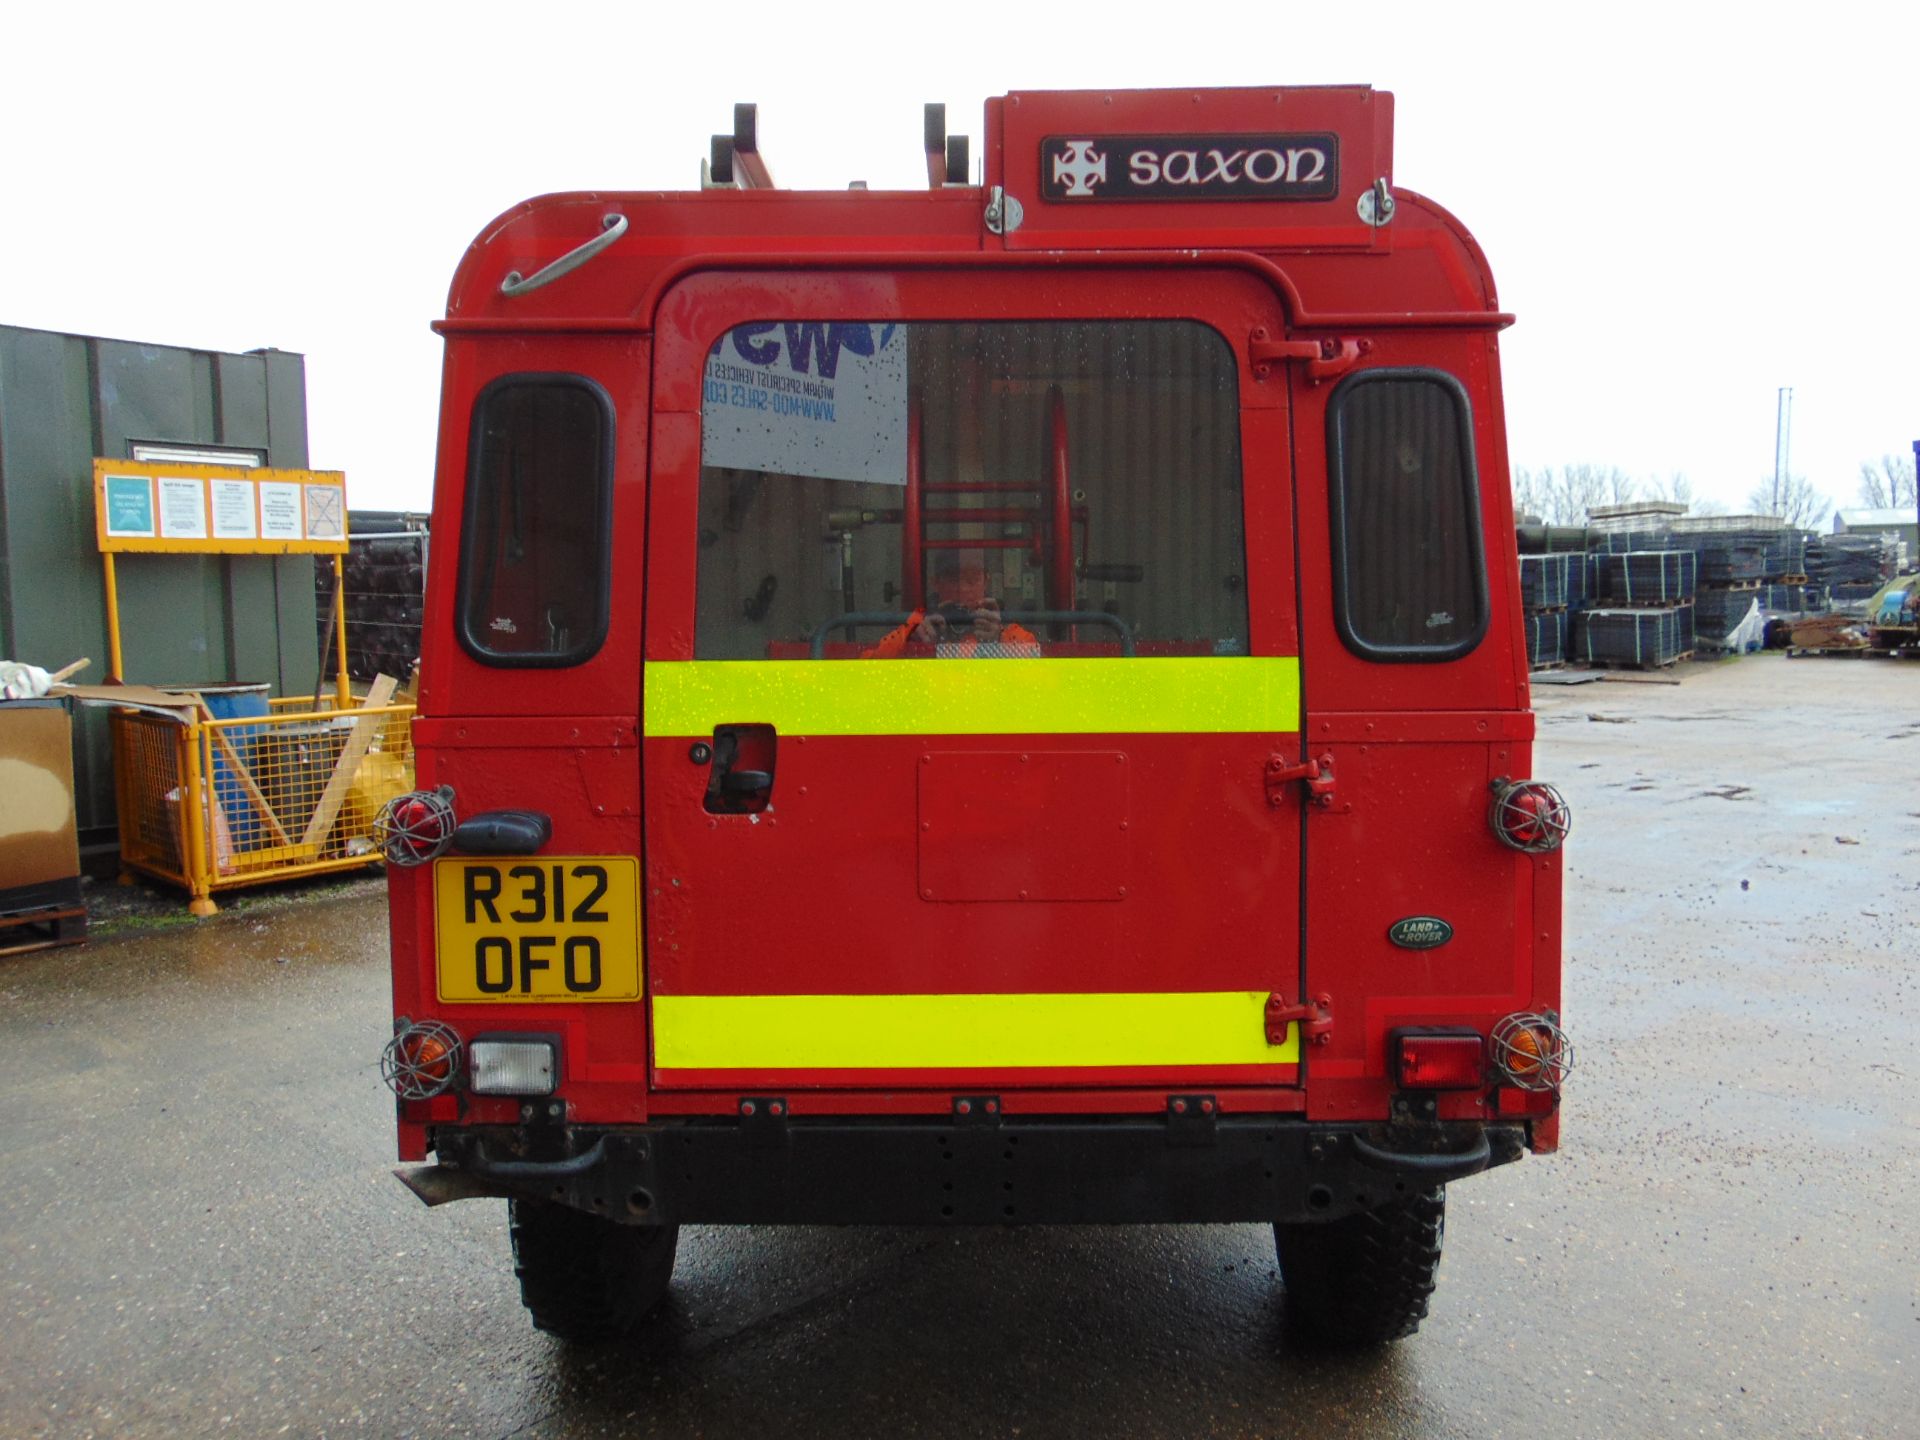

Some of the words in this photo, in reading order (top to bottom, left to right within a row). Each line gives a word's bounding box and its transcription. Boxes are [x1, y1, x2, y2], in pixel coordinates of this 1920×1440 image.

[464, 866, 609, 923] R312
[1403, 922, 1433, 933] LAND
[475, 935, 601, 993] OFO
